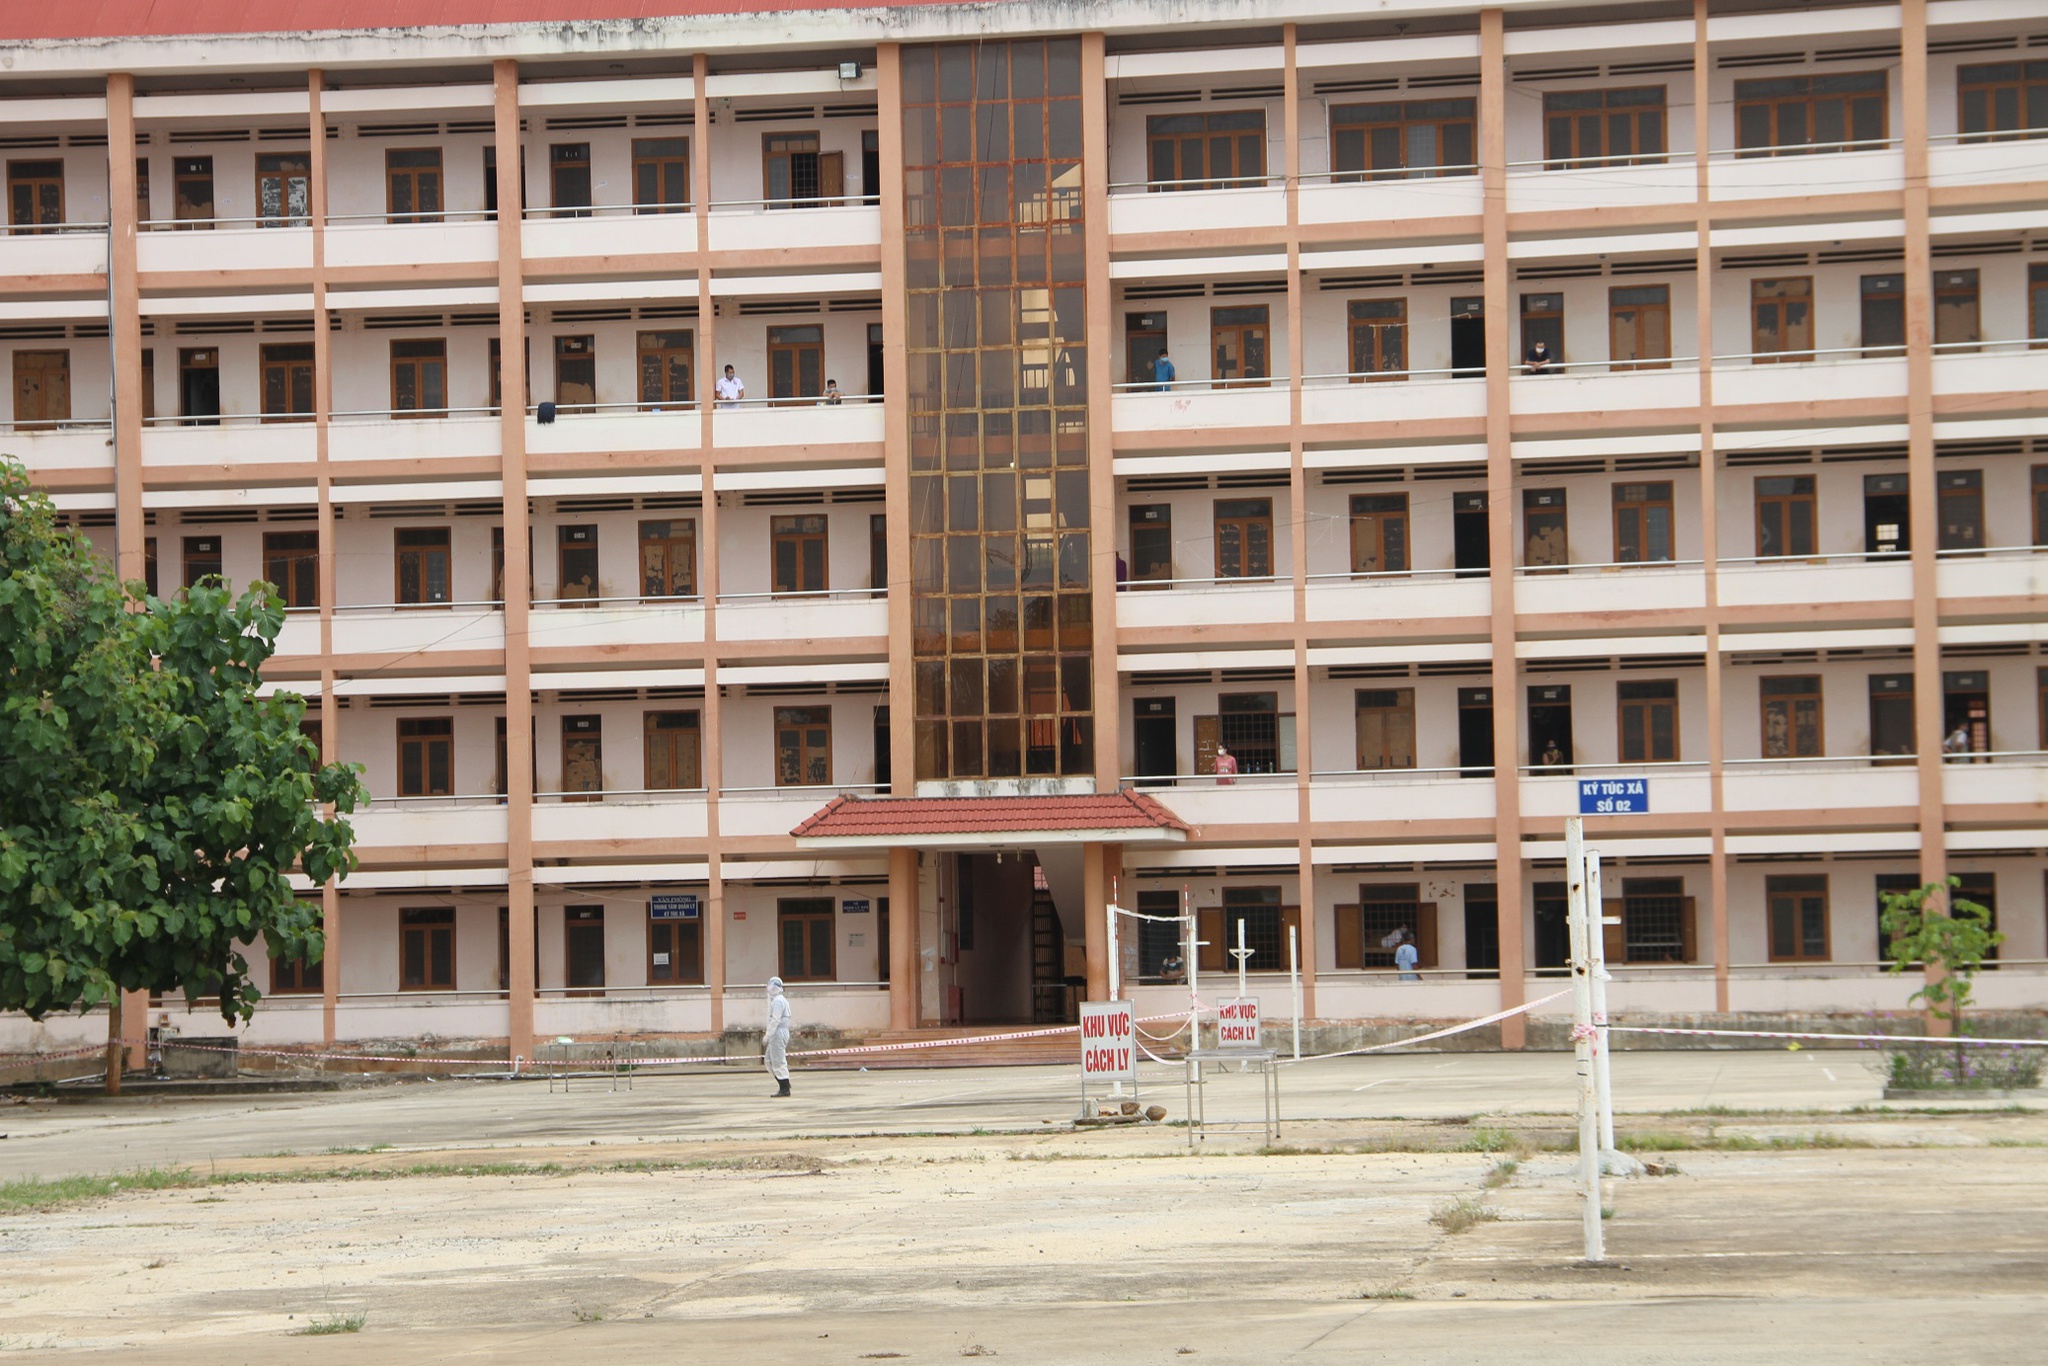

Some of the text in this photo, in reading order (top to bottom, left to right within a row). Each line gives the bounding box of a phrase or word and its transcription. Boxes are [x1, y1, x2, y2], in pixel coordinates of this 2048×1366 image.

[1583, 781, 1599, 795] KÝ
[1601, 781, 1624, 795] TÚC
[1596, 796, 1631, 812] SỐ 02
[1219, 1003, 1256, 1022] KHU VỰC
[1083, 1011, 1130, 1041] KHU VỰC
[1221, 1023, 1256, 1041] CÁCH LY
[1085, 1045, 1130, 1073] CÁCH LY
